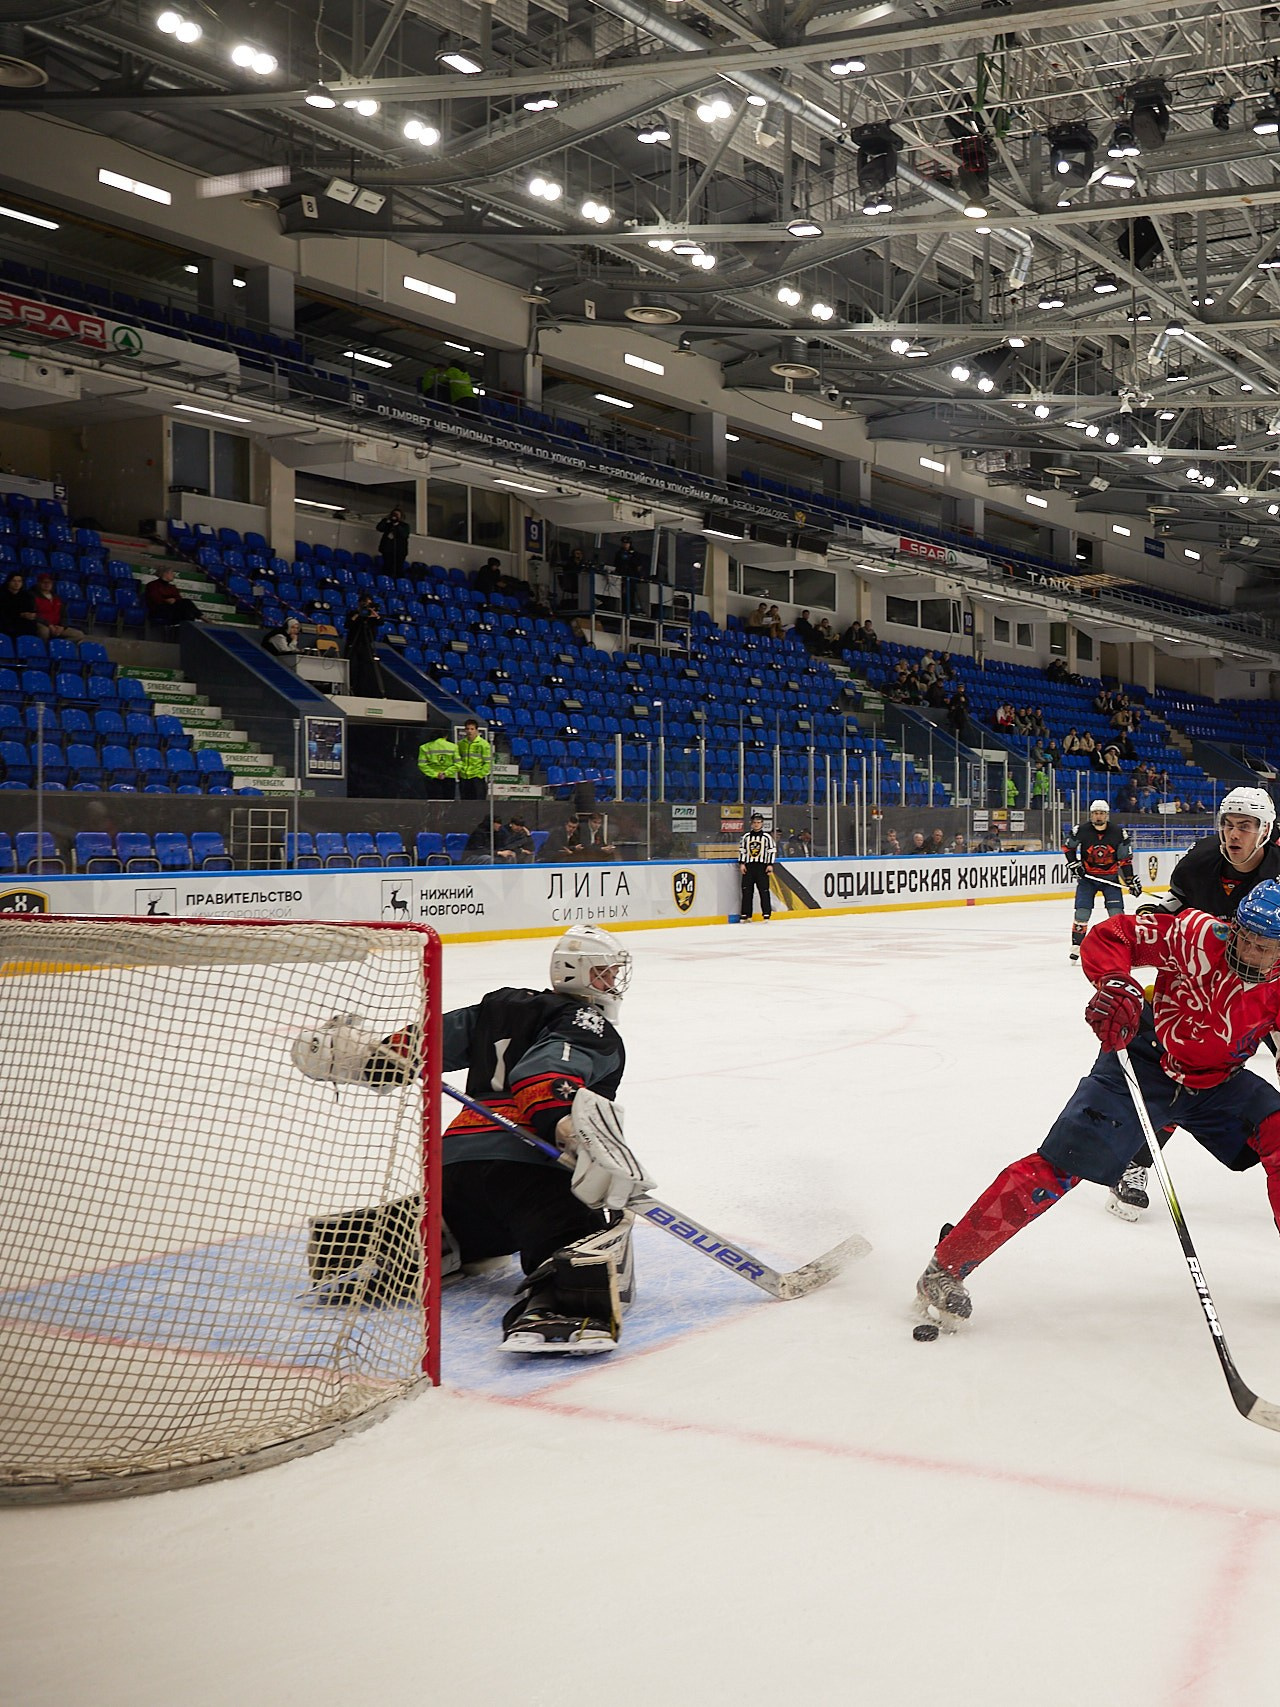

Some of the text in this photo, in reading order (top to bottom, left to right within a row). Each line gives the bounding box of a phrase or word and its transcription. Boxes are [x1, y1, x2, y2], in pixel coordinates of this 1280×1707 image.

[306, 201, 314, 213] 8
[377, 404, 431, 428] OLIMPBET
[434, 419, 494, 447] ЧЕМПИОНАТ
[496, 437, 534, 457] РОССИИ
[535, 447, 550, 460] ПО
[551, 451, 587, 470] ХОККЕЮ
[599, 464, 666, 490] ВСЕРОССИЙСКАЯ
[666, 481, 710, 502] ХОККЕЙНАЯ
[530, 523, 539, 541] 9
[910, 543, 947, 561] SPAR
[147, 682, 181, 692] SYNERGETIC
[171, 706, 206, 716] SYNERGETIC
[198, 730, 232, 739] SYNERGETIC
[225, 754, 259, 763] SYNERGETIC
[252, 779, 285, 788] SYNERGETIC
[547, 870, 631, 900] ЛИГА
[823, 868, 951, 900] ОФИЦЕРСКАЯ
[957, 859, 1048, 890] ХОККЕЙНАЯ
[186, 890, 303, 906] ПРАВИТЕЛЬСТВО
[419, 884, 475, 900] НИЖНИЙ
[419, 902, 485, 917] НОВГОРОД
[551, 904, 629, 922] СИЛЬНЫХ
[560, 1041, 571, 1062] 1
[490, 1037, 513, 1092] 1
[644, 1206, 765, 1281] BAUER
